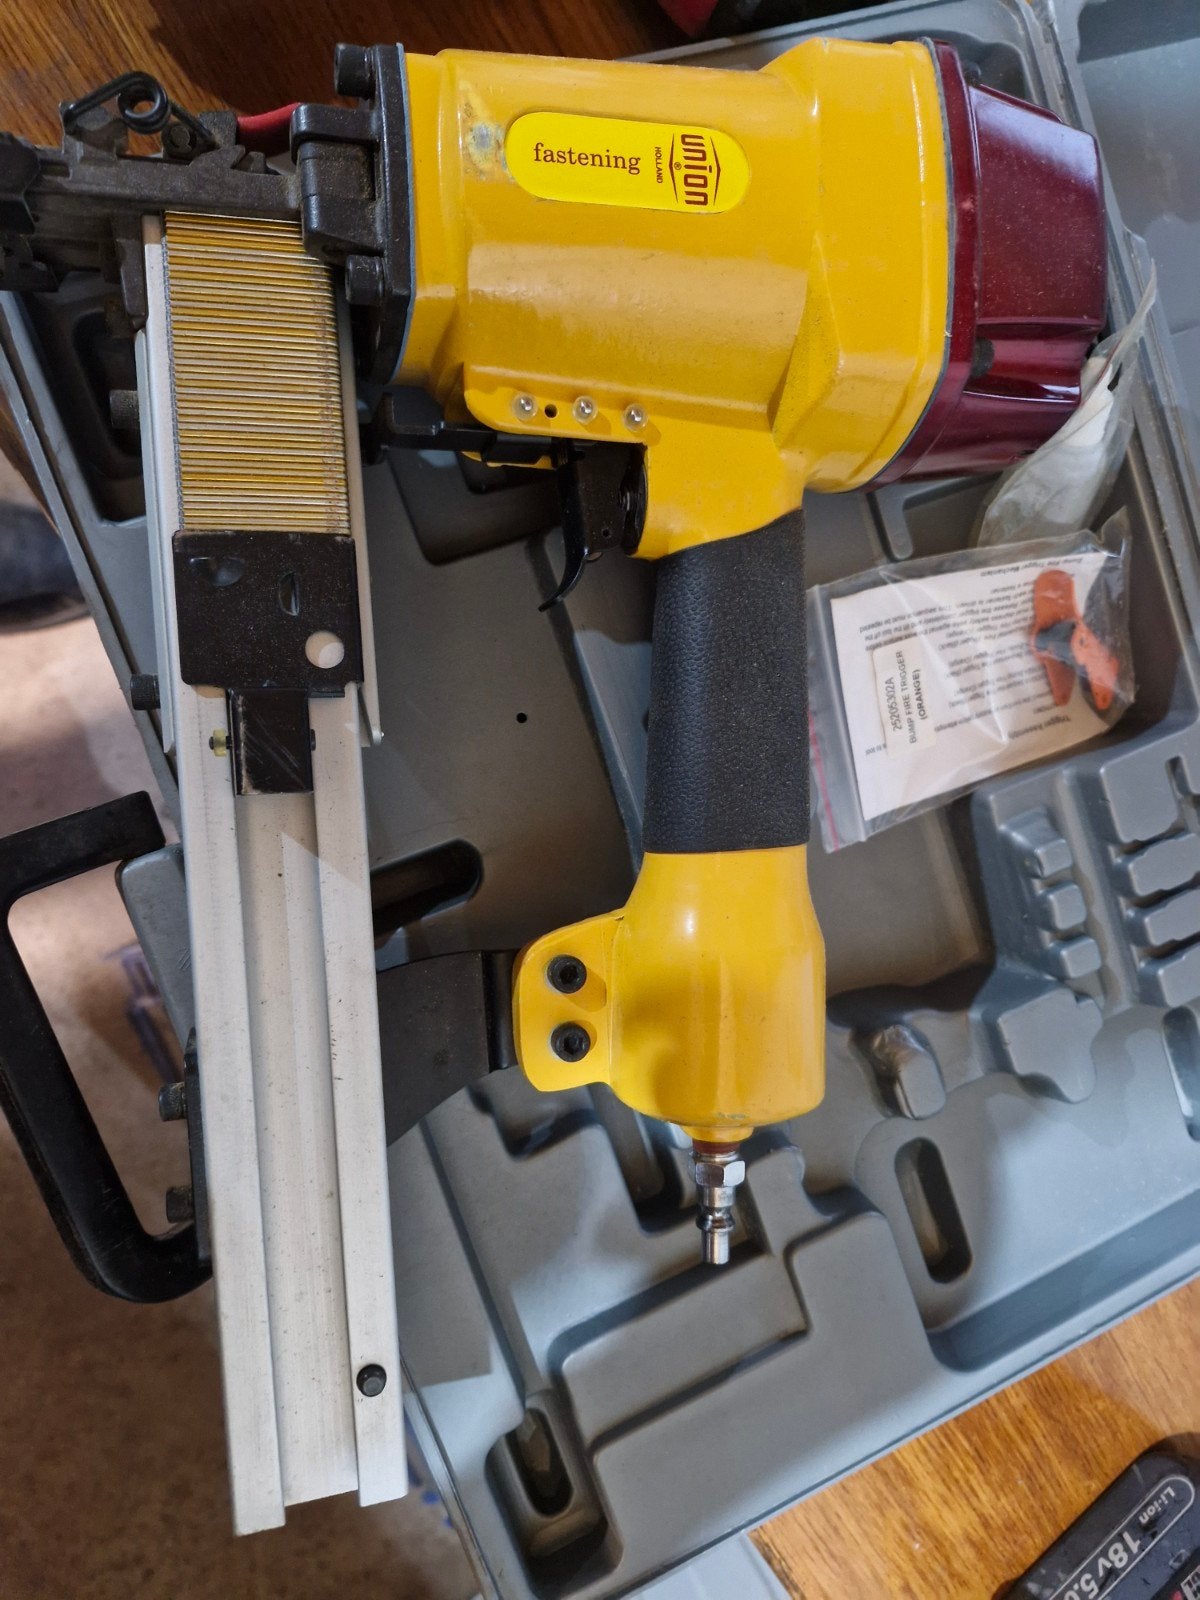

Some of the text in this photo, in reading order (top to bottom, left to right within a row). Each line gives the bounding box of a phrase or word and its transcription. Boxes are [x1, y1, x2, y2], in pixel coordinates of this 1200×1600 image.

[534, 142, 641, 175] fastening
[655, 147, 663, 183] HOLLAND
[681, 134, 711, 205] union
[980, 566, 1019, 576] Mechanism
[858, 621, 883, 632] repeated
[885, 676, 901, 731] 25205302A
[895, 650, 916, 743] BUMP FIRE TRIGGER
[912, 668, 927, 719] (ORANGE)
[1138, 1487, 1175, 1524] Li-ion
[1098, 1531, 1140, 1577] 18v
